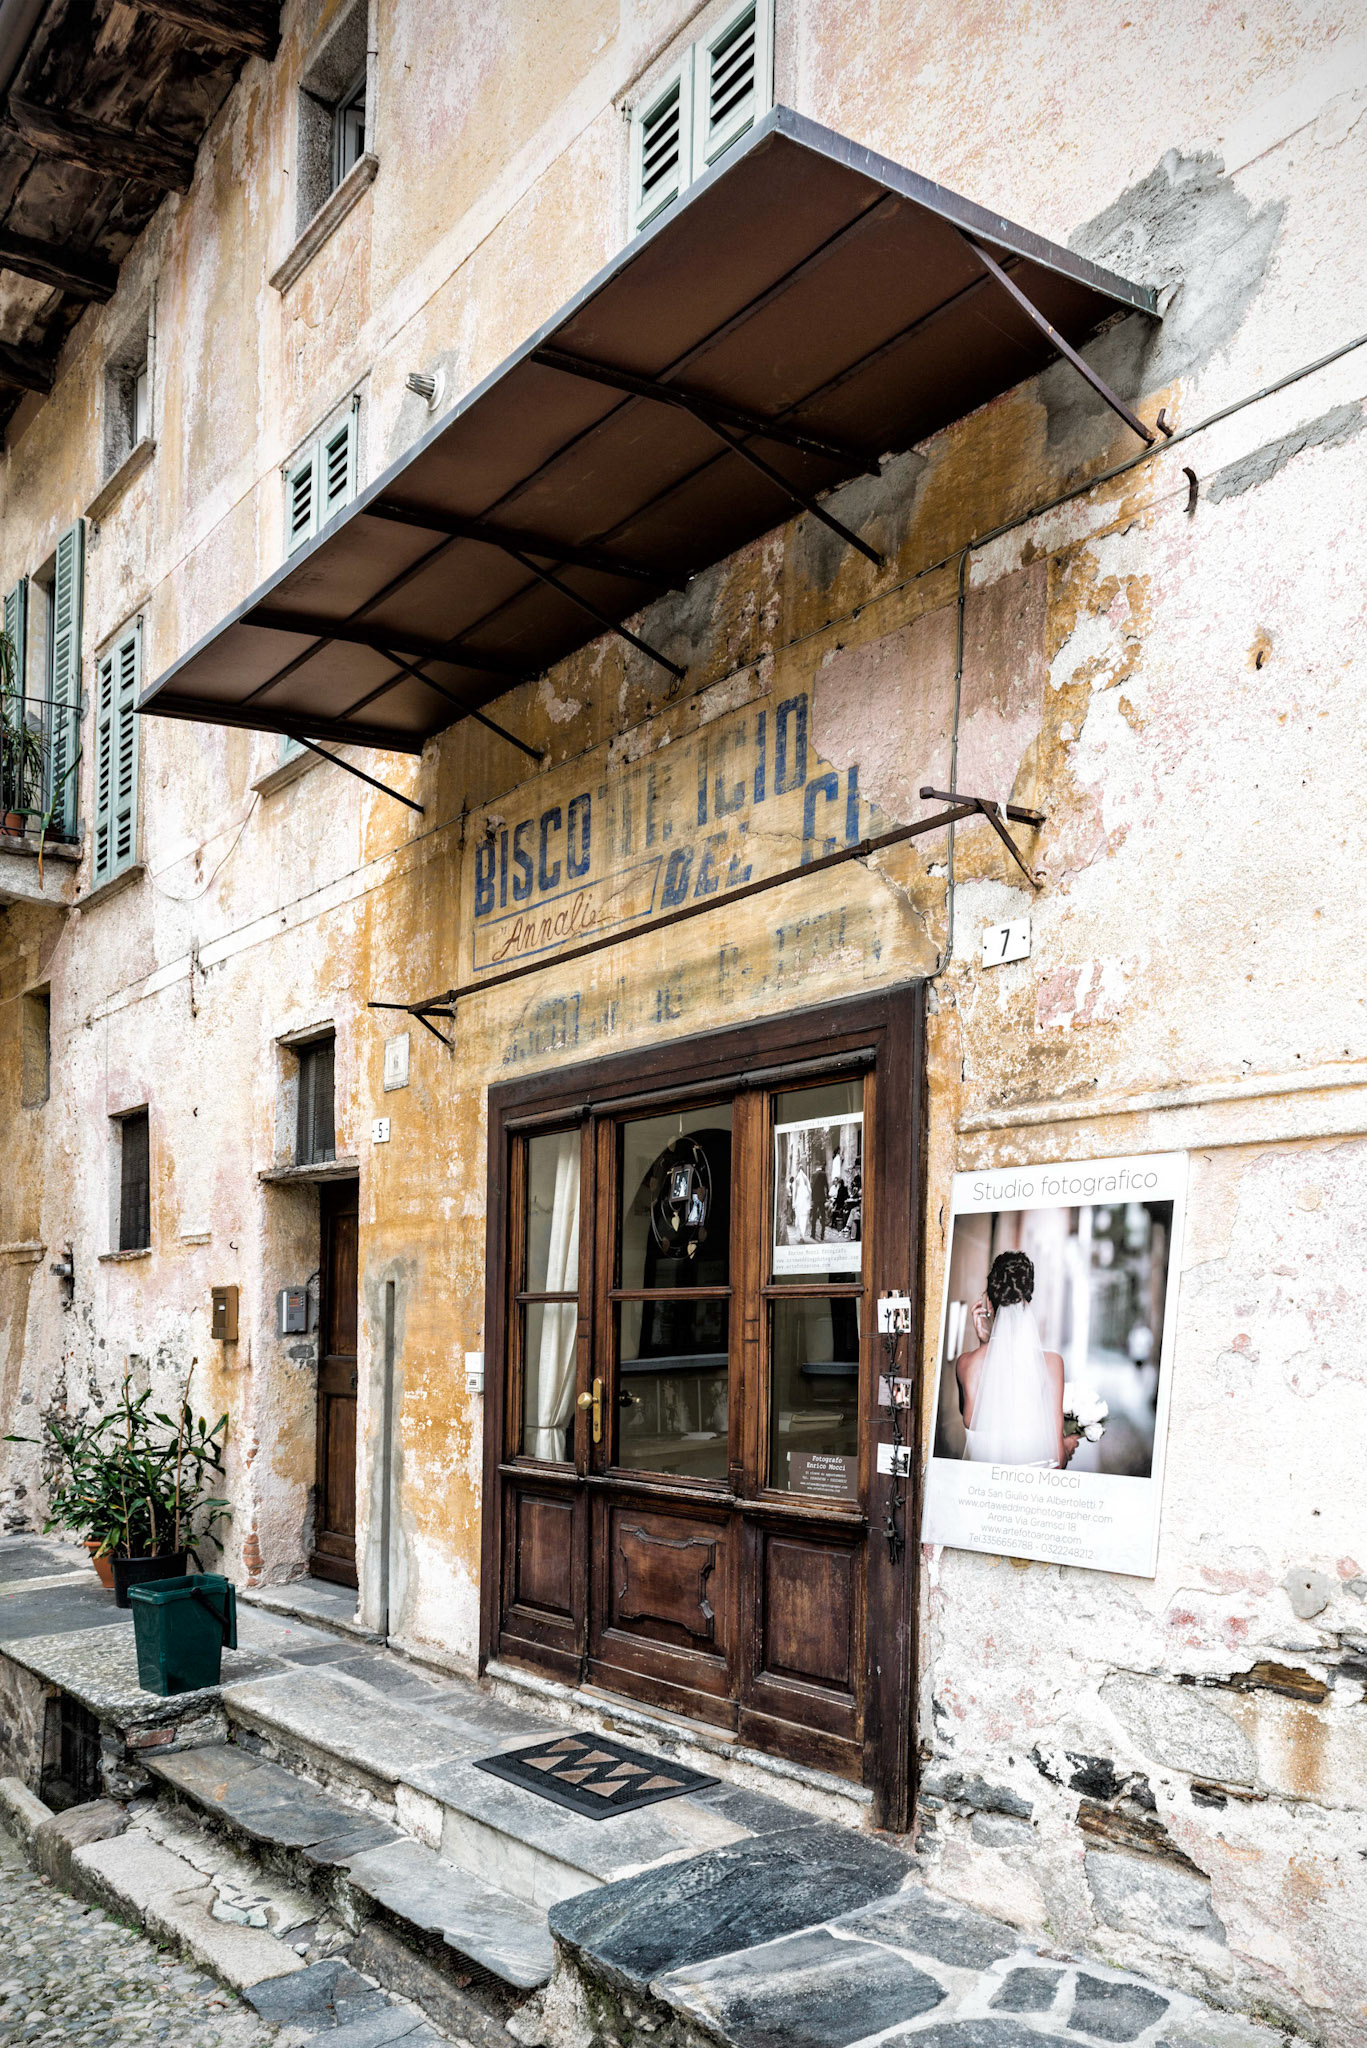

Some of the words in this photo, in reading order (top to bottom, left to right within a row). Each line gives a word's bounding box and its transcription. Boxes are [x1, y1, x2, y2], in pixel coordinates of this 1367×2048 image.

[1001, 928, 1010, 957] 7
[973, 1179, 1034, 1201] Studio
[1041, 1169, 1158, 1197] fotografico
[806, 1461, 827, 1470] Enrico
[828, 1464, 846, 1472] Mocci
[812, 1455, 843, 1464] Fotografo
[991, 1466, 1035, 1484] Enrico
[1038, 1471, 1081, 1489] Mocci
[968, 1486, 985, 1497] Orta
[987, 1488, 1002, 1499] San
[1005, 1490, 1029, 1502] Giulio
[1030, 1493, 1044, 1504] Via
[1047, 1495, 1097, 1510] Albertoletti
[1098, 1500, 1105, 1511] 7
[958, 1497, 1113, 1524] www.ortaweddingphotographer.com
[987, 1513, 1013, 1524] Arona
[1015, 1516, 1029, 1526] Via
[1030, 1517, 1066, 1531] Gramsci
[1068, 1521, 1077, 1533] 18
[980, 1524, 1082, 1545] www.artefotoarona.com
[1040, 1543, 1094, 1560] 0322248212
